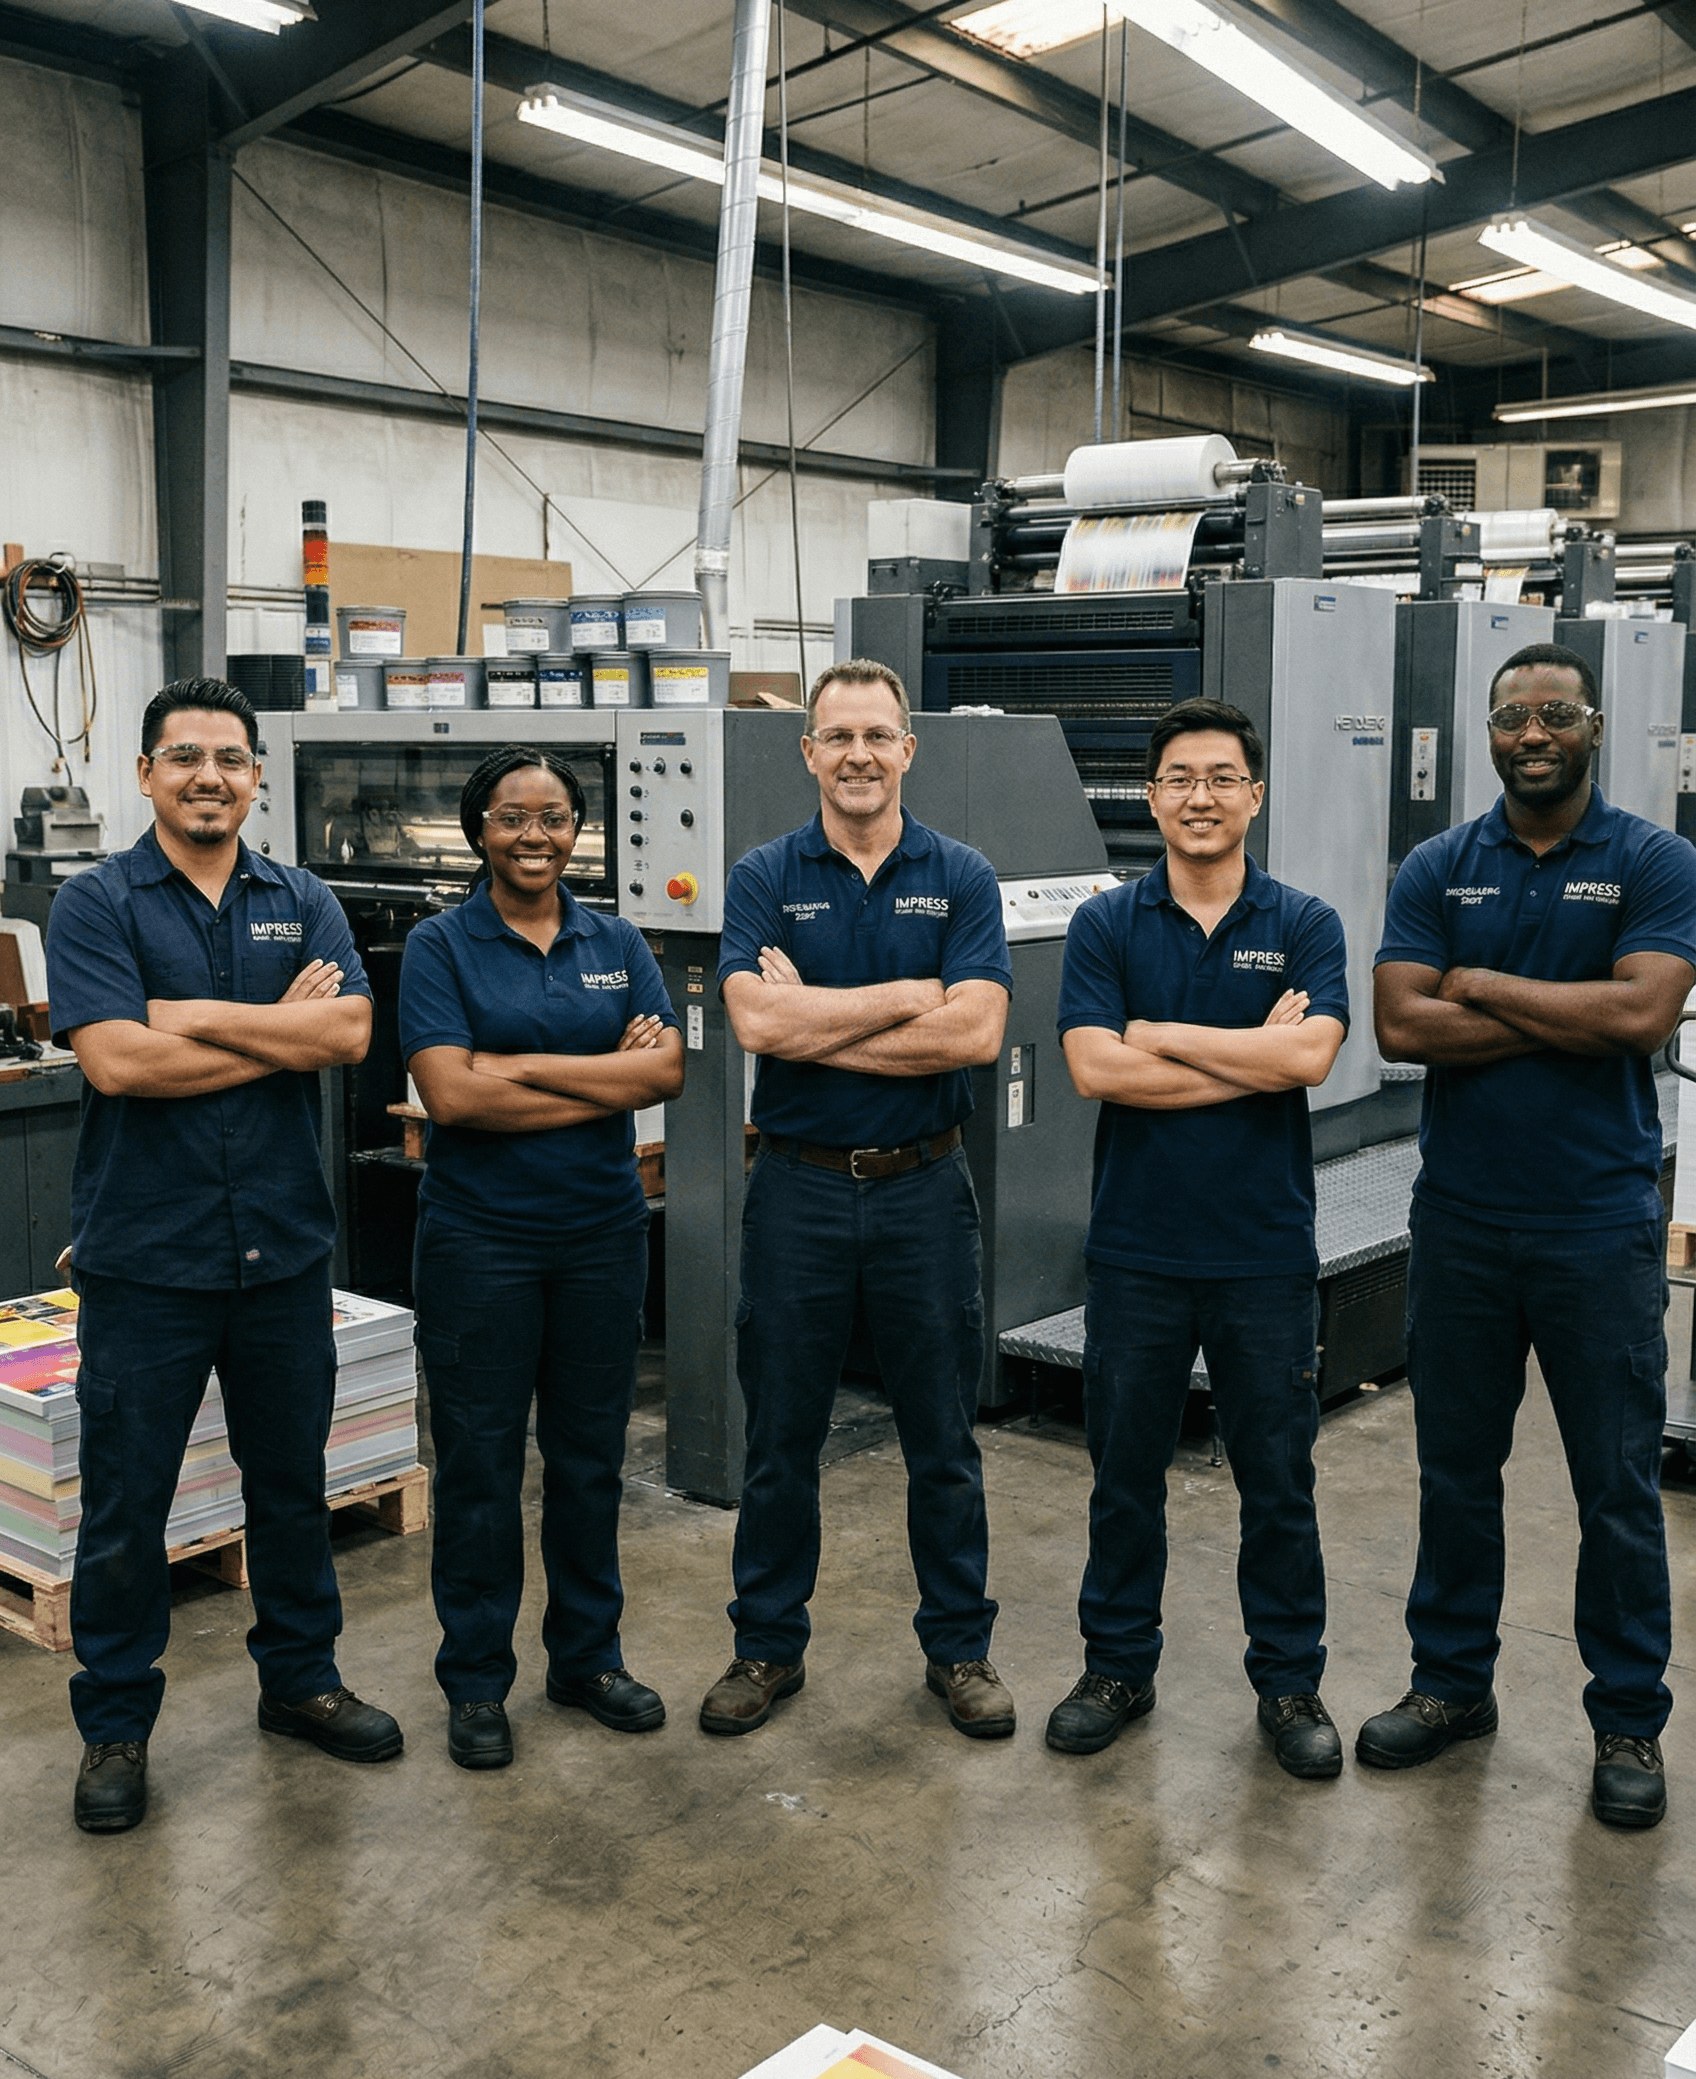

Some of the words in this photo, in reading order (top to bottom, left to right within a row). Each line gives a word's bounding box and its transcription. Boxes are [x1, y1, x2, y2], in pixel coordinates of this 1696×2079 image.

[1564, 881, 1621, 898] IMPRESS
[895, 896, 949, 911] IMPRESS
[250, 922, 302, 936] IMPRESS
[1233, 950, 1285, 966] IMPRESS
[580, 969, 629, 984] IMPRESS
